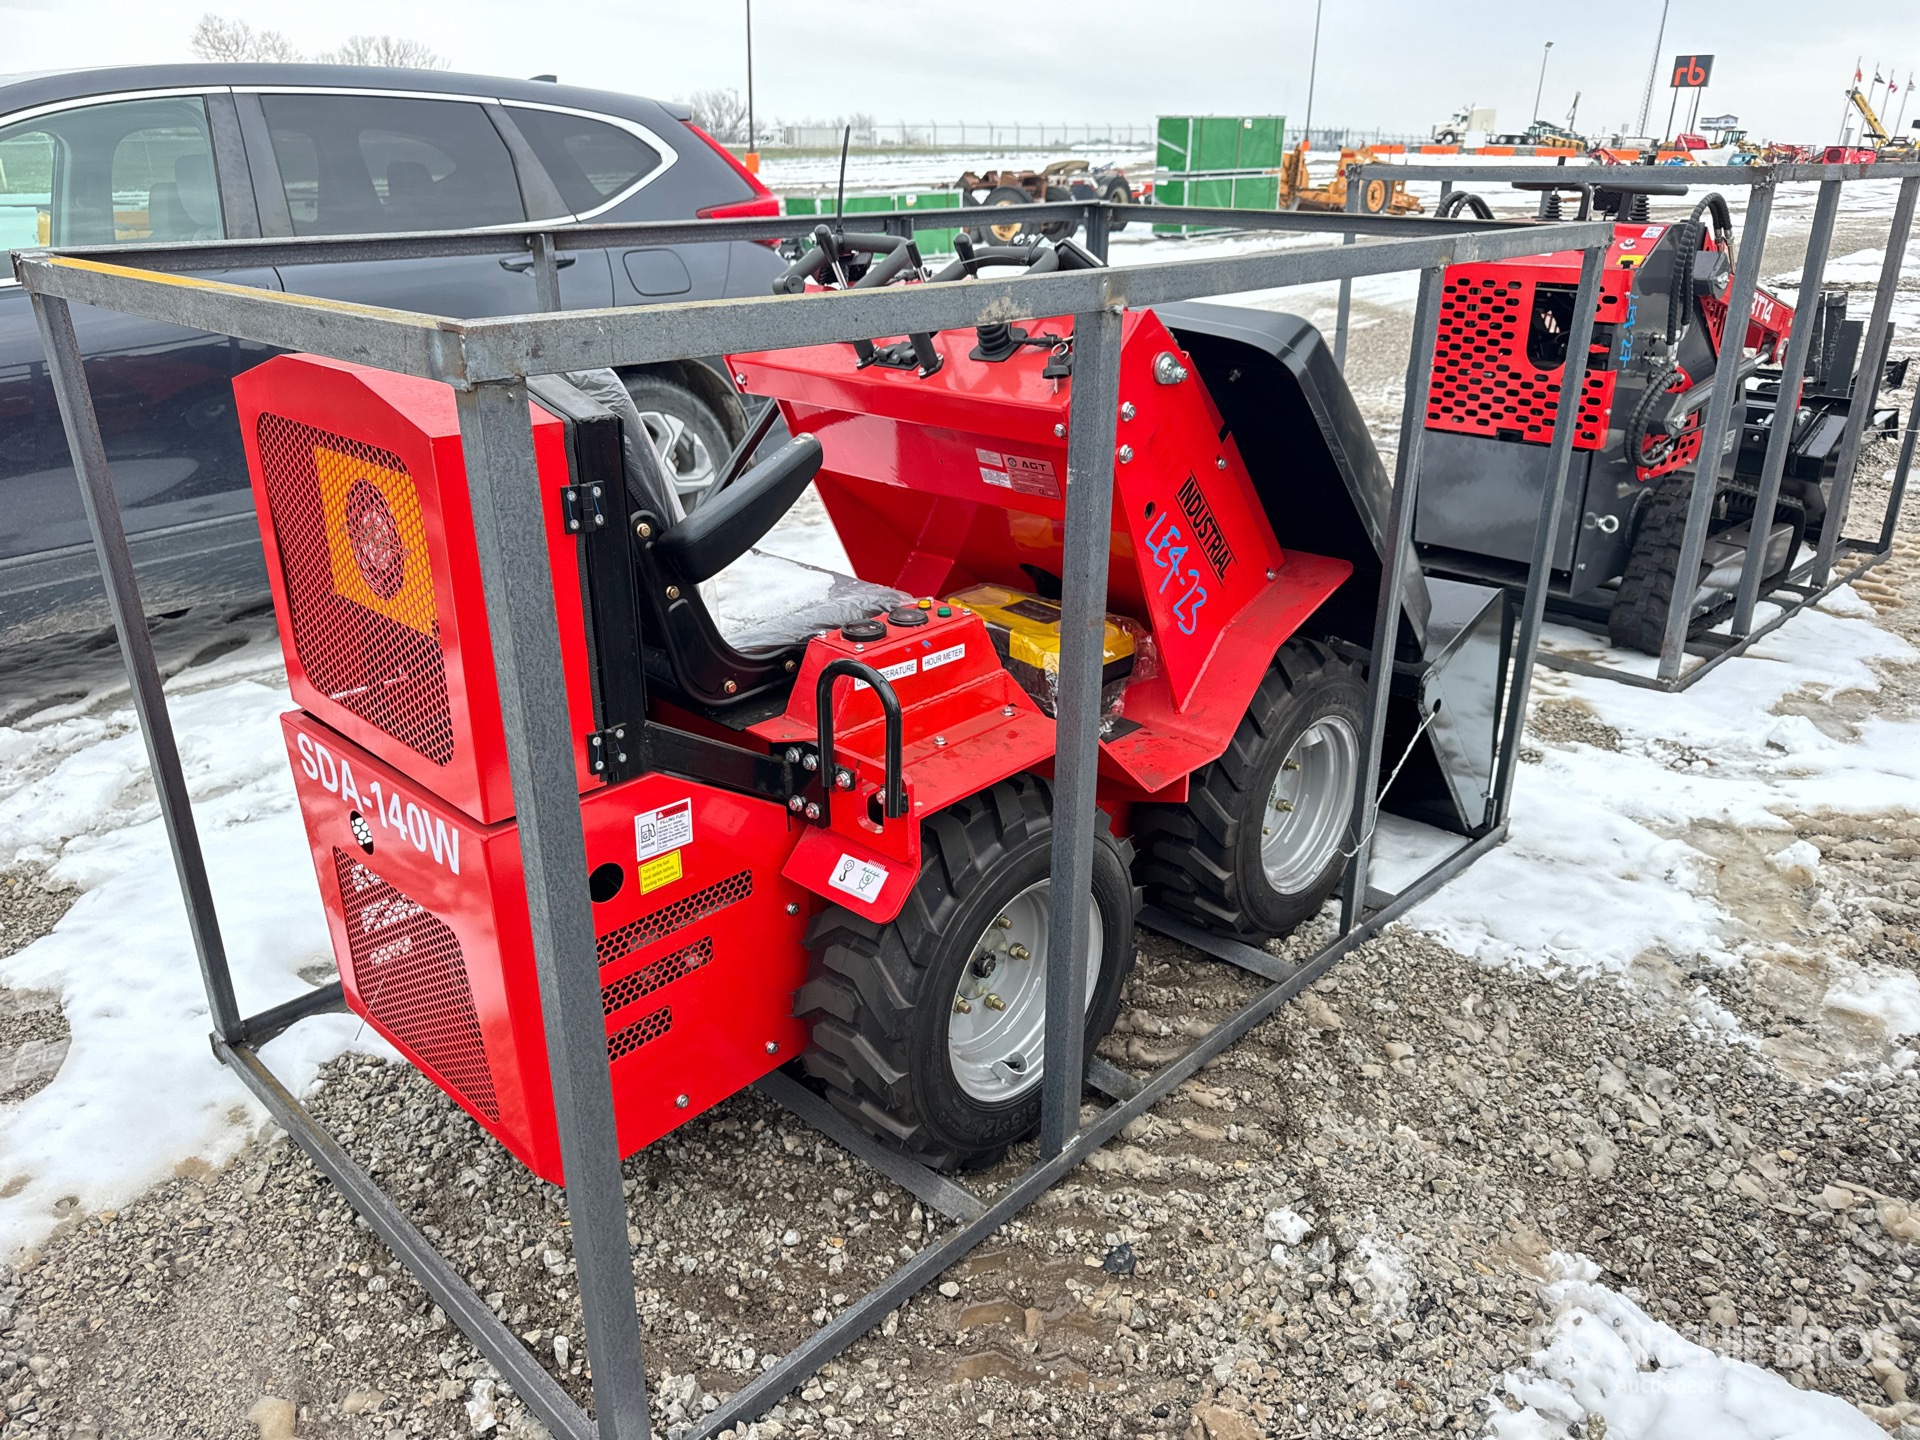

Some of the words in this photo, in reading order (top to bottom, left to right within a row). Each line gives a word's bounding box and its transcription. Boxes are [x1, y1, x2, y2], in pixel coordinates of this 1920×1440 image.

[1674, 55, 1706, 87] rb
[1021, 460, 1047, 472] AGT
[1177, 476, 1233, 579] INDUSTRIAL
[924, 655, 943, 668] HOUR
[942, 647, 964, 662] METER
[297, 732, 460, 876] SDA-140W
[660, 816, 676, 825] FILLING
[675, 812, 687, 820] FUEL
[640, 840, 656, 850] GASOLINE
